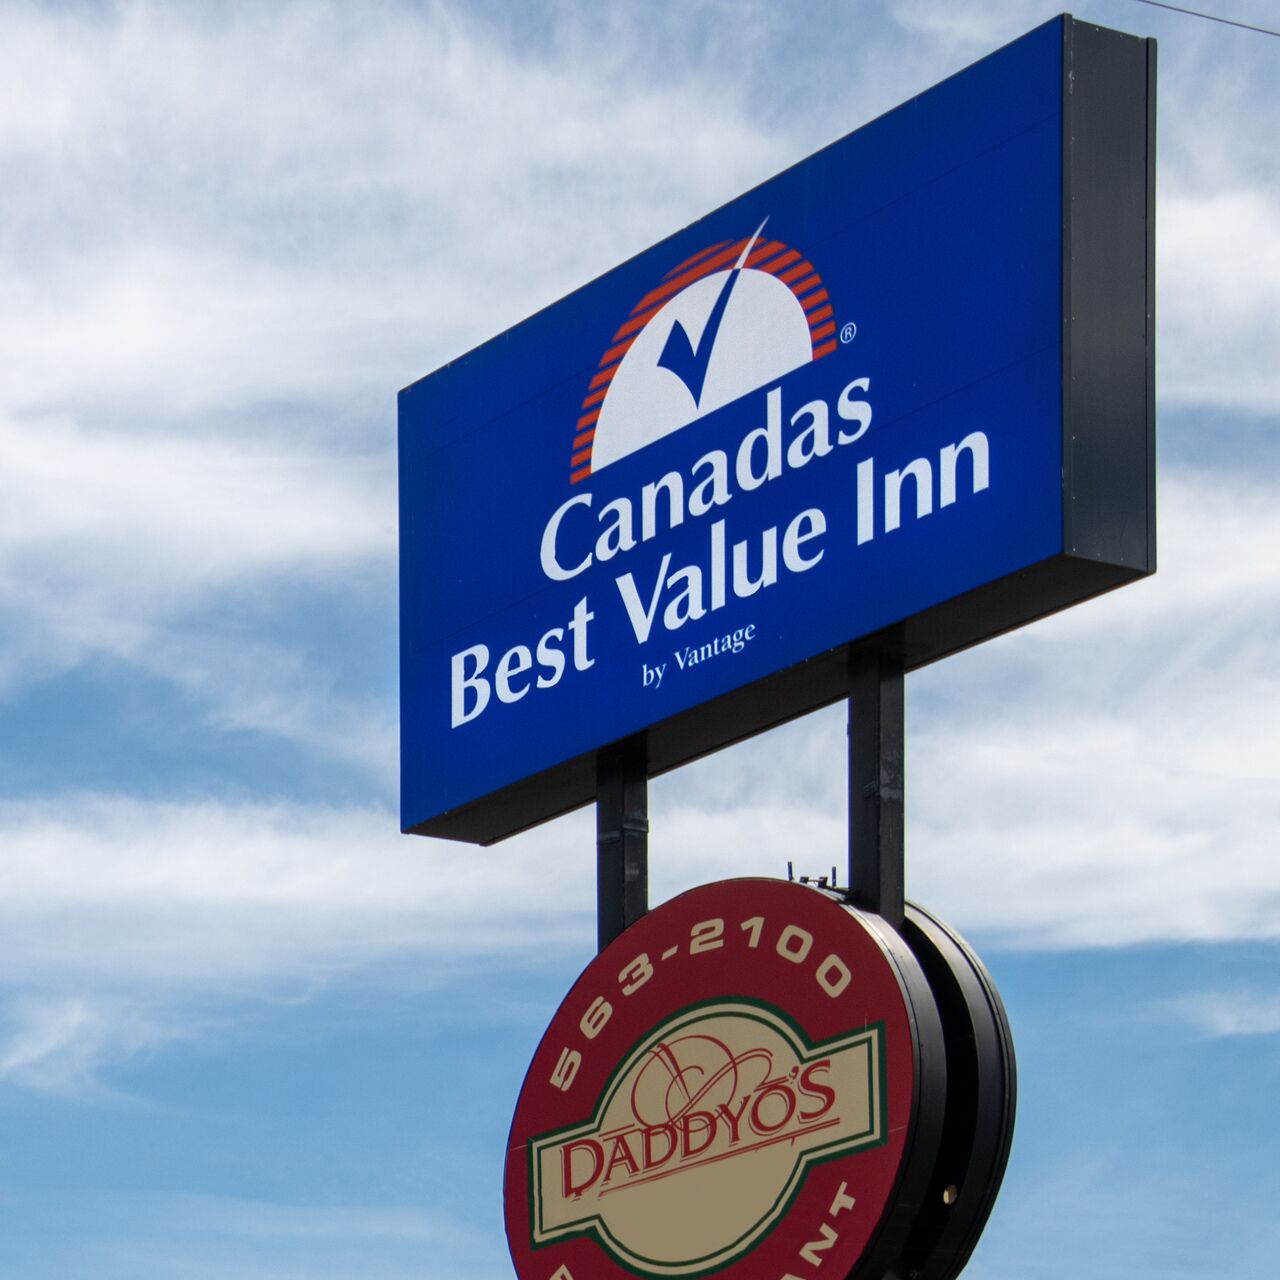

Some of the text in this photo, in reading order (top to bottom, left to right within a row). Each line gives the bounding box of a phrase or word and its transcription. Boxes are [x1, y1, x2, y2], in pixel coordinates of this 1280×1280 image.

[540, 376, 873, 581] Canadas
[451, 431, 990, 730] Best Value Inn
[642, 622, 757, 688] by Vantage
[550, 916, 852, 1092] 563-2100
